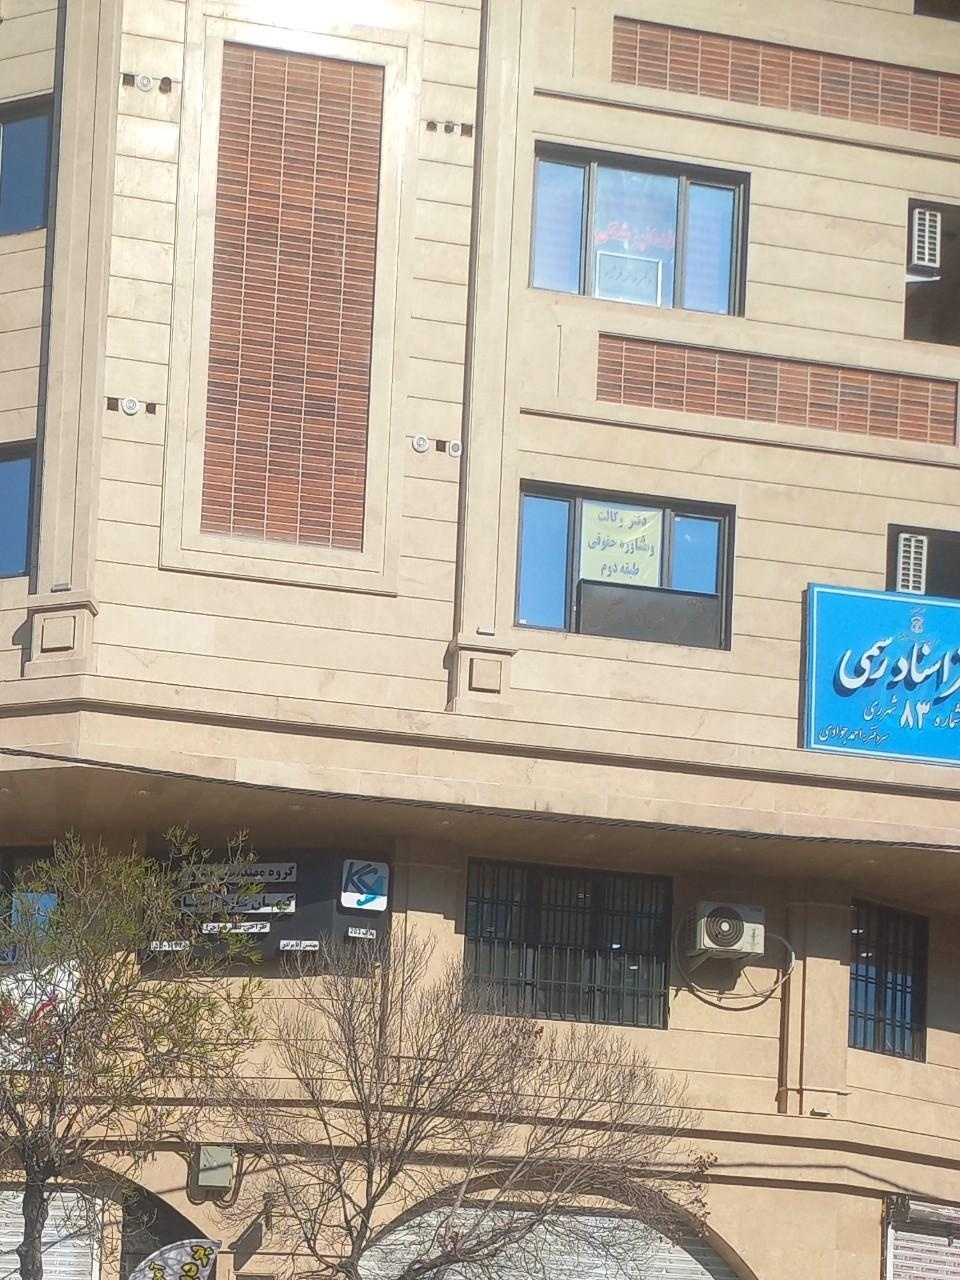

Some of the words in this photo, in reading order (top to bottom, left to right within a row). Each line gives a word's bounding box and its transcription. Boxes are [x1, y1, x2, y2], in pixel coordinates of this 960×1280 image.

[598, 509, 623, 528] وکالت
[627, 513, 647, 529] دفتر
[588, 533, 617, 551] حقوقی
[601, 563, 618, 577] دوم
[621, 562, 640, 579] طبقه
[839, 637, 893, 689] رسمی
[892, 641, 951, 684] اسناد
[900, 699, 931, 729] ۸۳
[268, 865, 295, 881] گروه
